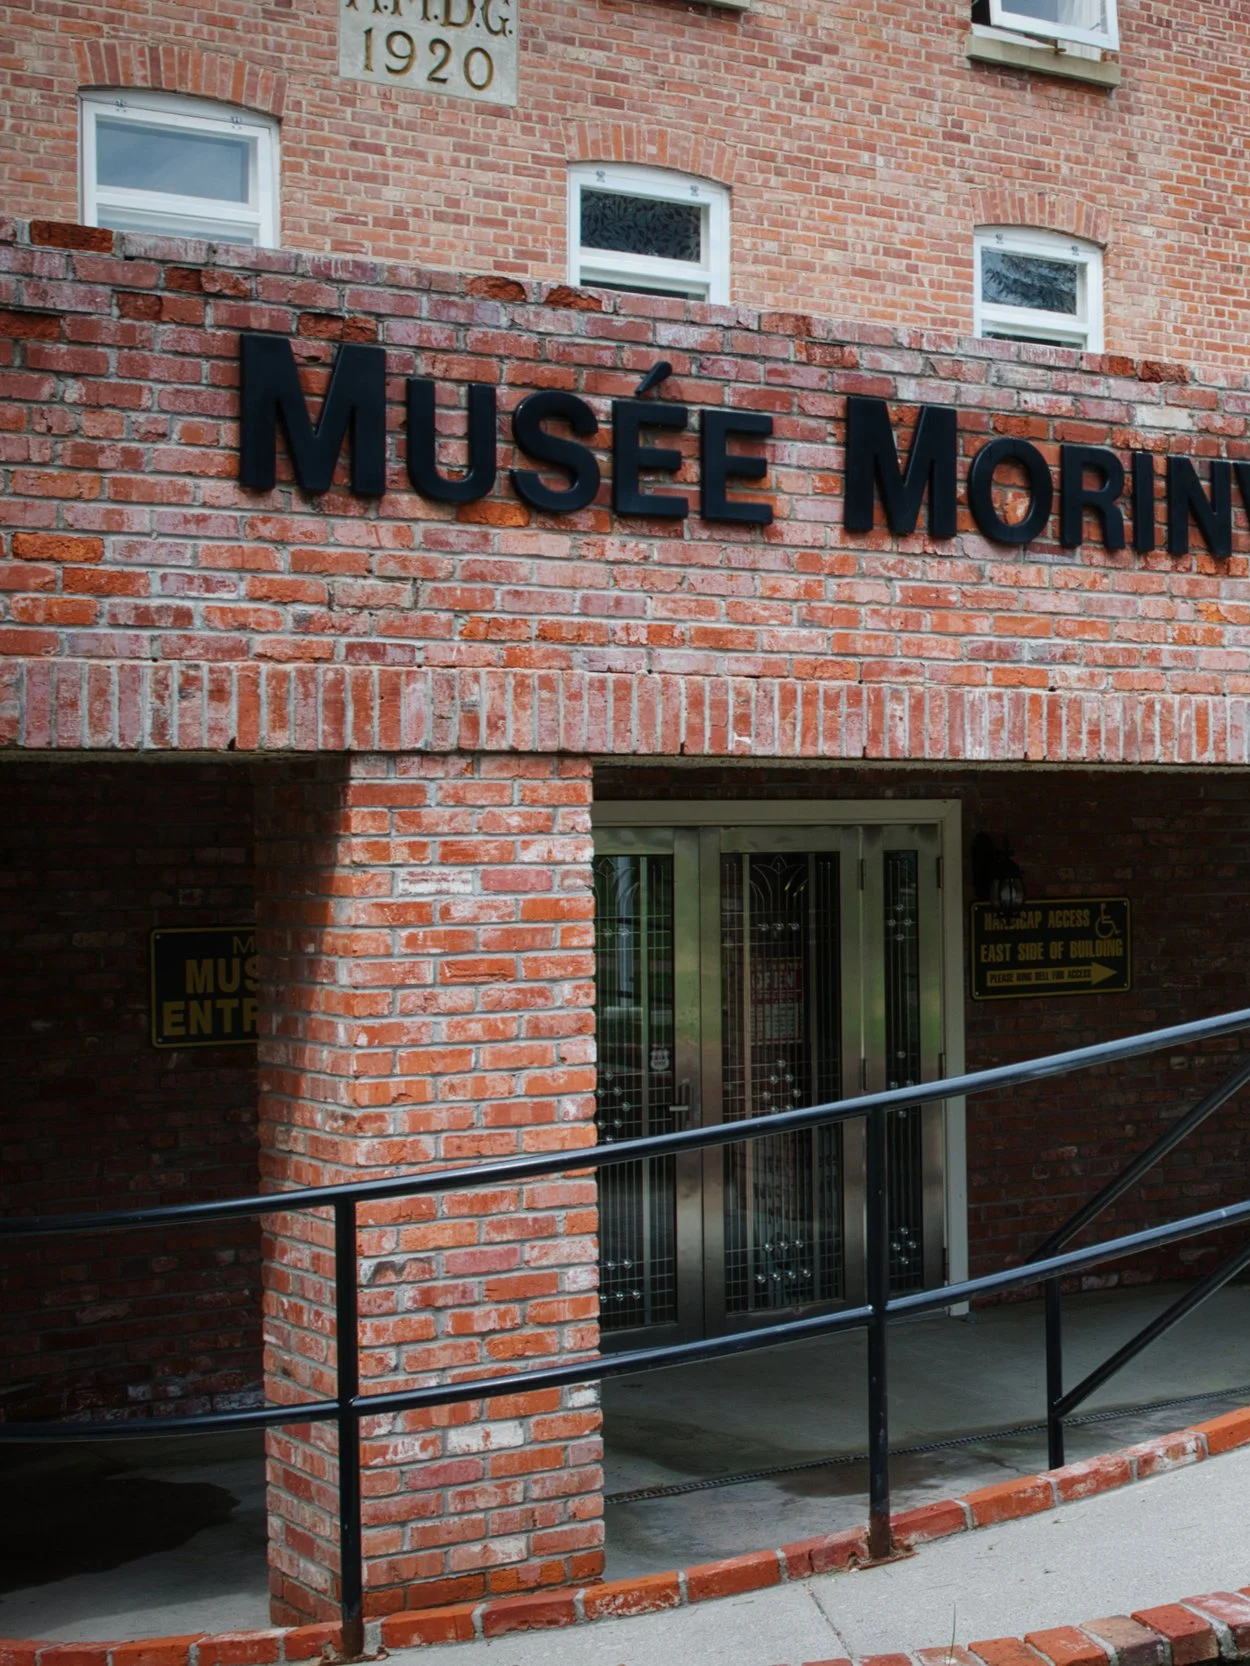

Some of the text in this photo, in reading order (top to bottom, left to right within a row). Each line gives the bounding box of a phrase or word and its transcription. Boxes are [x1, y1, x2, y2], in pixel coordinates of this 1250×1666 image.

[345, 0, 514, 38] ..D.G.
[363, 27, 495, 92] 1920
[238, 333, 775, 530] MUSÉE
[1047, 909, 1090, 928] ACCESS
[980, 939, 1124, 963] EAST SIDE OF BUILDING
[989, 973, 1013, 984] PLEASE
[1035, 972, 1049, 981] BELL
[1052, 971, 1064, 980] FOR
[1067, 969, 1091, 980] ACCESS
